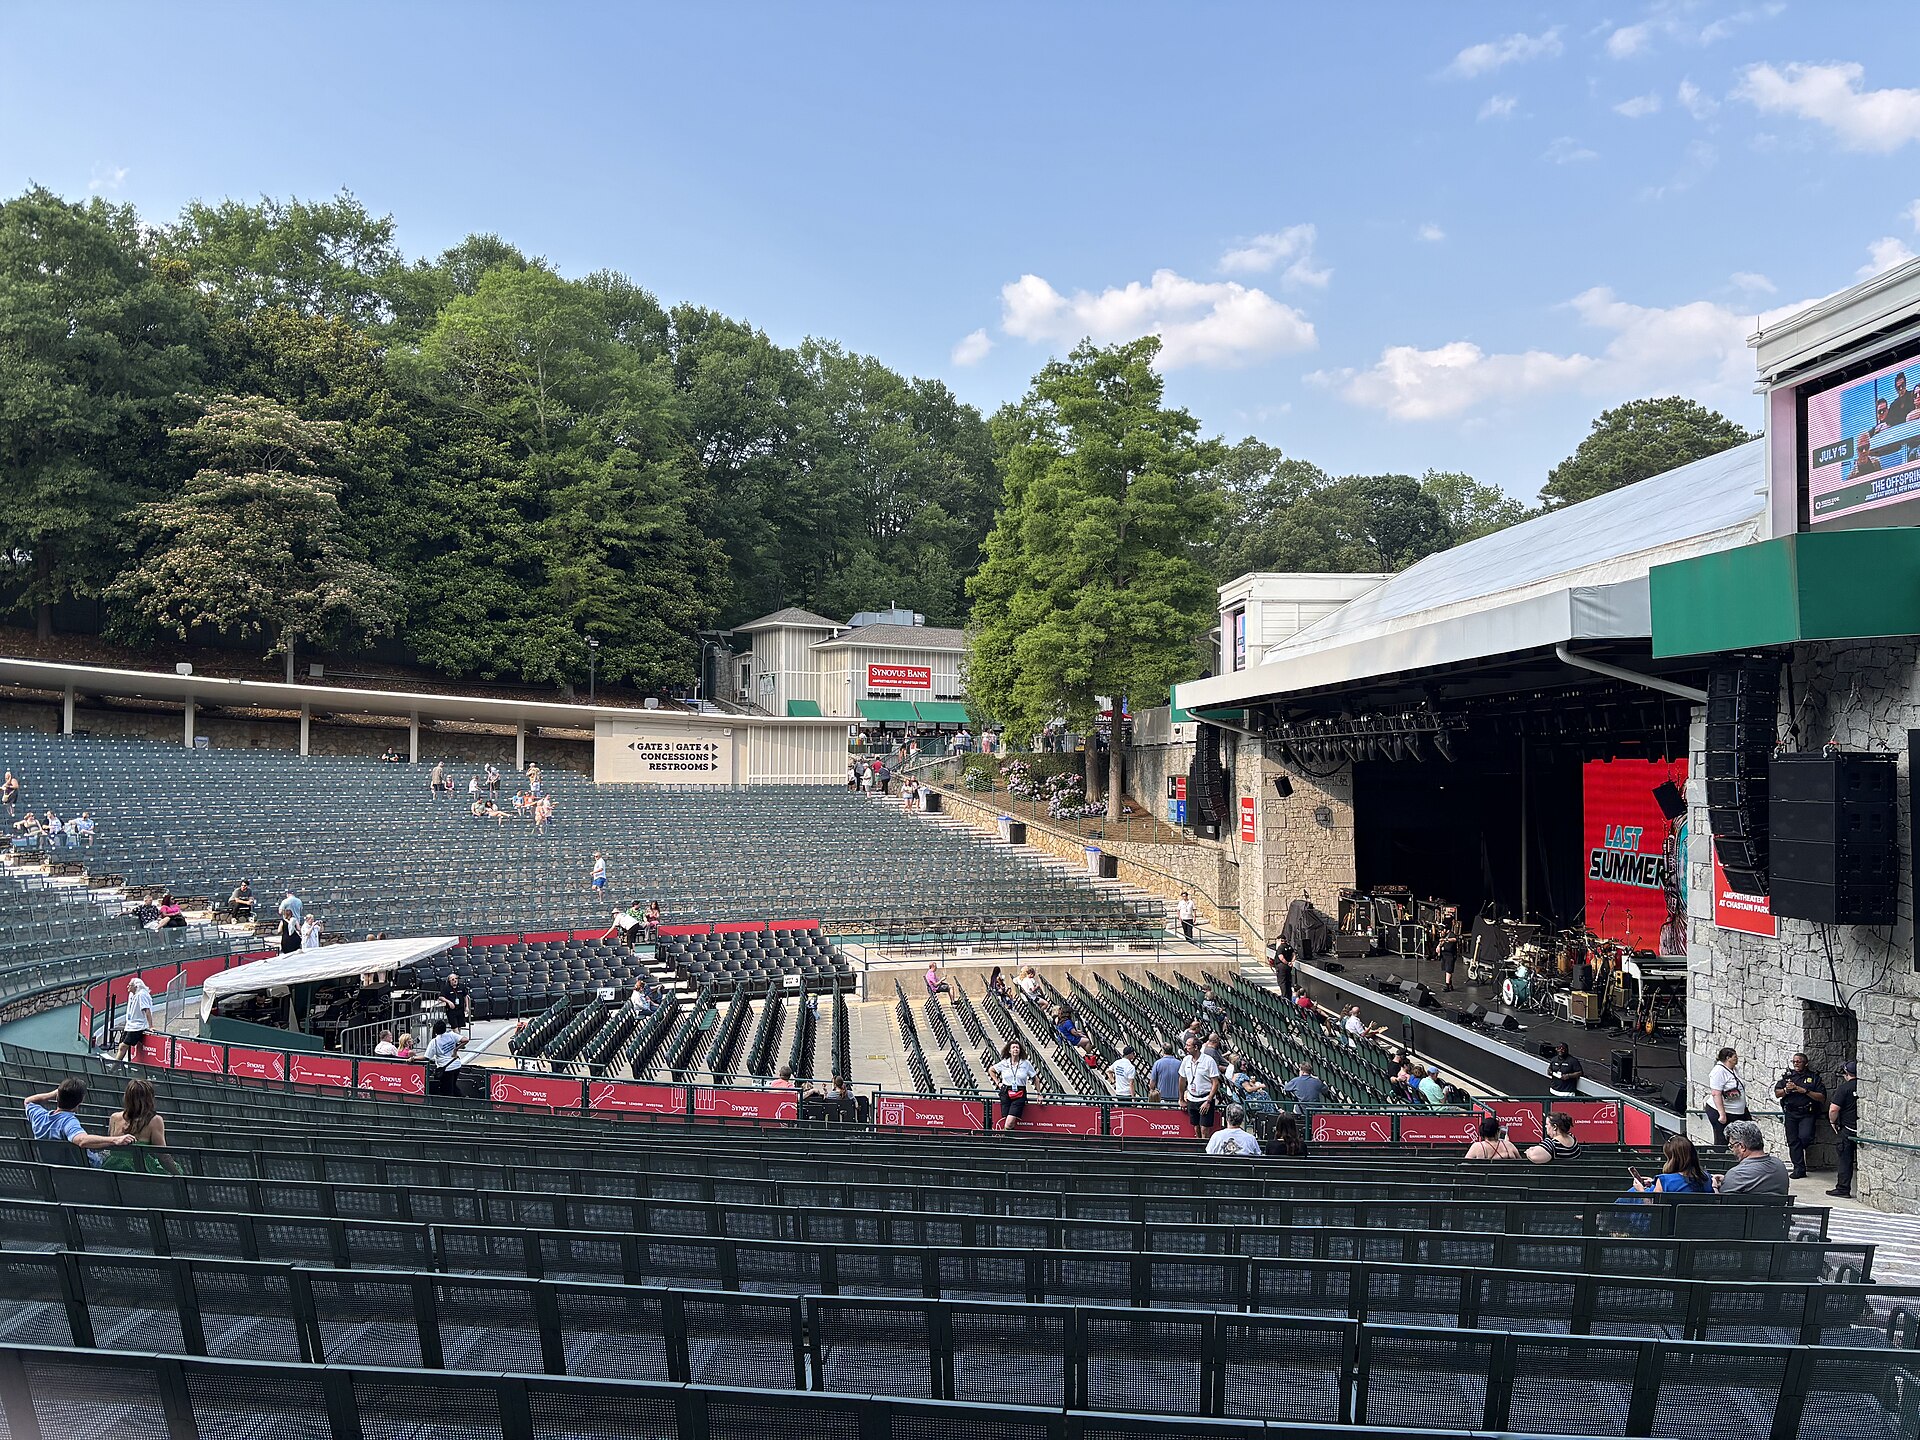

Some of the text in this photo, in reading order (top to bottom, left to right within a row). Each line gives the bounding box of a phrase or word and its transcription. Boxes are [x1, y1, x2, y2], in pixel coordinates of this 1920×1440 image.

[1819, 444, 1847, 462] JULY 15
[1871, 479, 1886, 493] THE
[872, 667, 928, 678] SYNOVUS BANK
[637, 743, 663, 751] GATE
[664, 743, 670, 751] 3
[641, 753, 709, 761] CONCESSIONS
[649, 763, 709, 771] RESTROOMS
[1604, 824, 1643, 851] LAST
[1589, 847, 1666, 890] SUMMER
[1723, 891, 1764, 904] AMPHITHEATER
[1726, 901, 1753, 911] CHASTAIN
[1754, 905, 1769, 914] PARK
[380, 1075, 402, 1083] SYNOVUS
[522, 1089, 547, 1098] SYNOVUS
[731, 1104, 758, 1112] SYNOVUS
[915, 1113, 944, 1121] SYNOVUS
[1150, 1122, 1180, 1130] SYNOVUS
[1336, 1129, 1367, 1137] SYNOVUS
